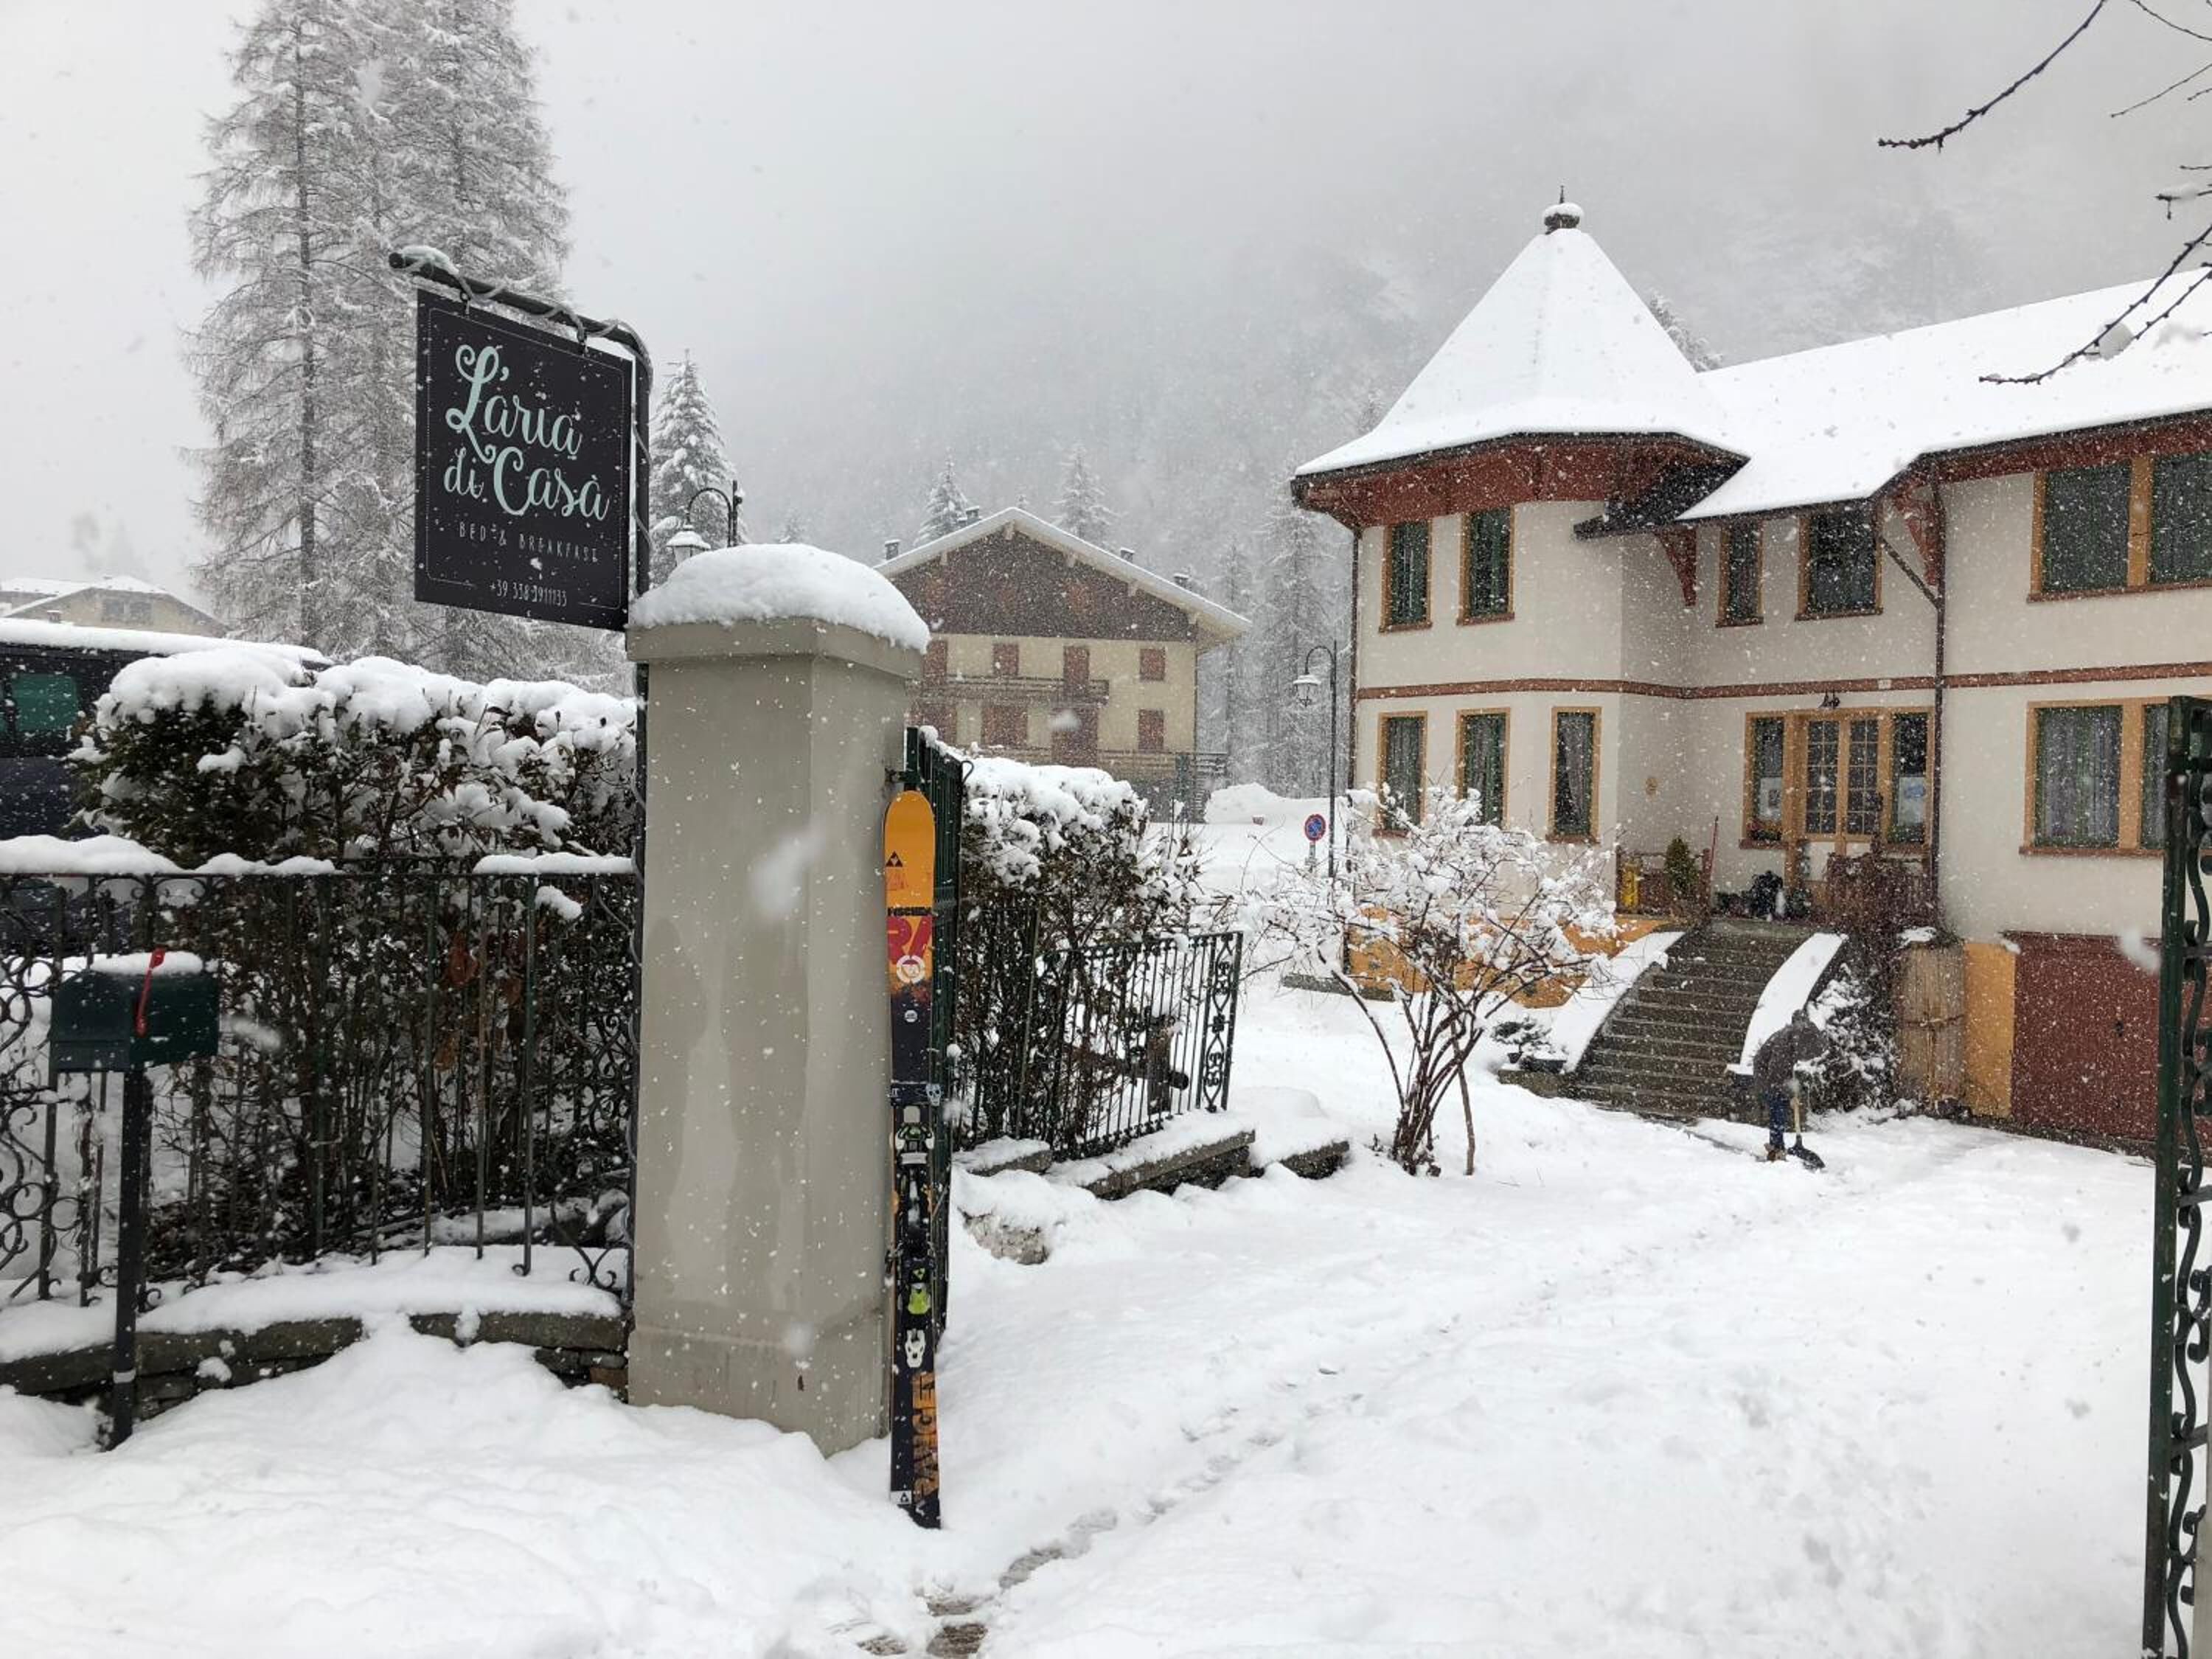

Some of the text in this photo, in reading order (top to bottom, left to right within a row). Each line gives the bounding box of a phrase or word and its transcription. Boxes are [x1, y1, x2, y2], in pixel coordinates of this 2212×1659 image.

[444, 446, 610, 521] di Casa
[459, 521, 599, 563] BED & BREAKFAST
[490, 579, 509, 599] +39
